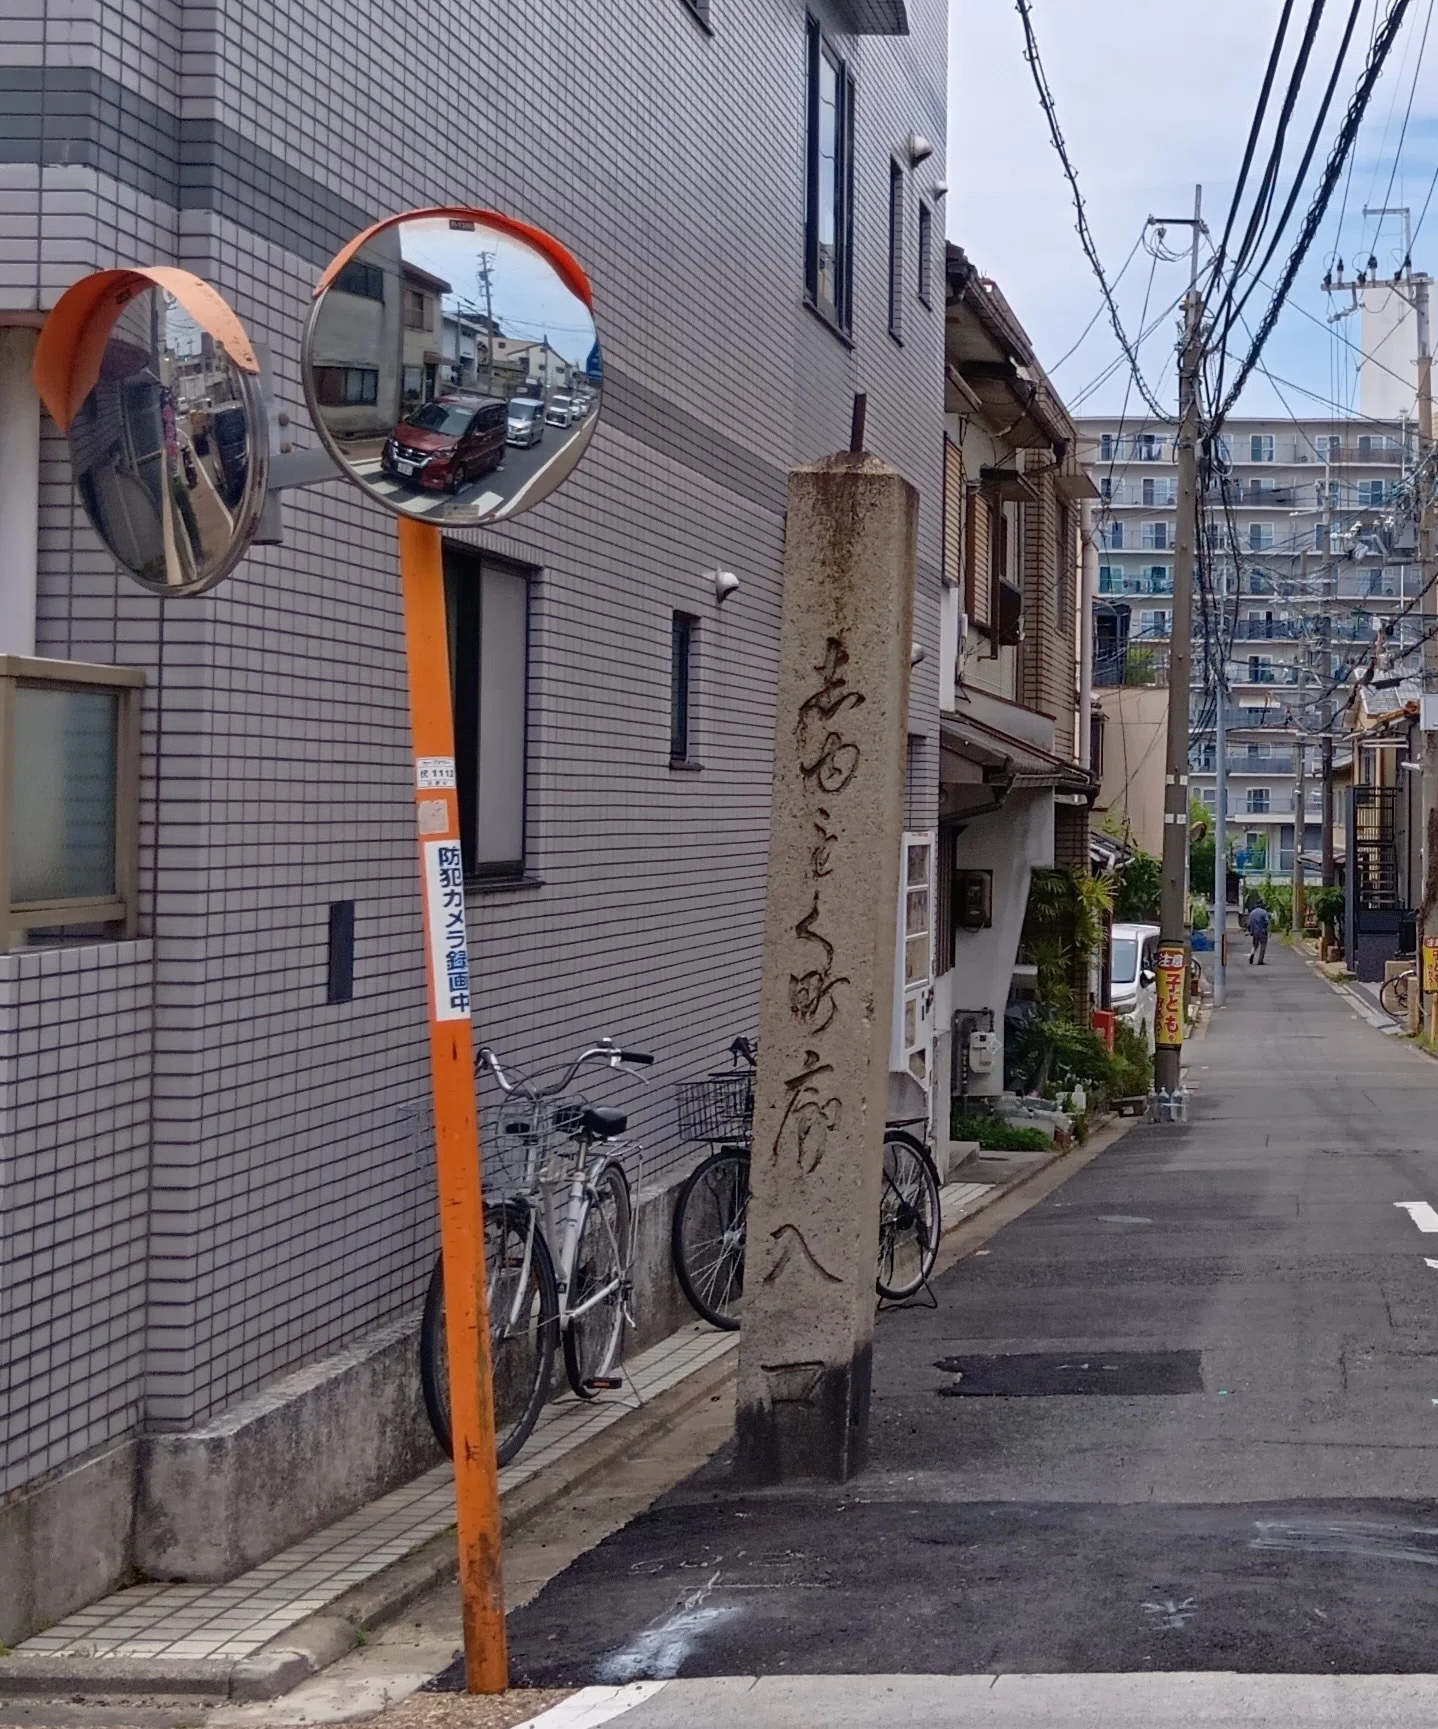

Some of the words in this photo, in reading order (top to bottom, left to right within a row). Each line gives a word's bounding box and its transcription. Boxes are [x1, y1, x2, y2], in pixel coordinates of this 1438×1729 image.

[438, 845, 470, 1013] 防犯カメラ録画中
